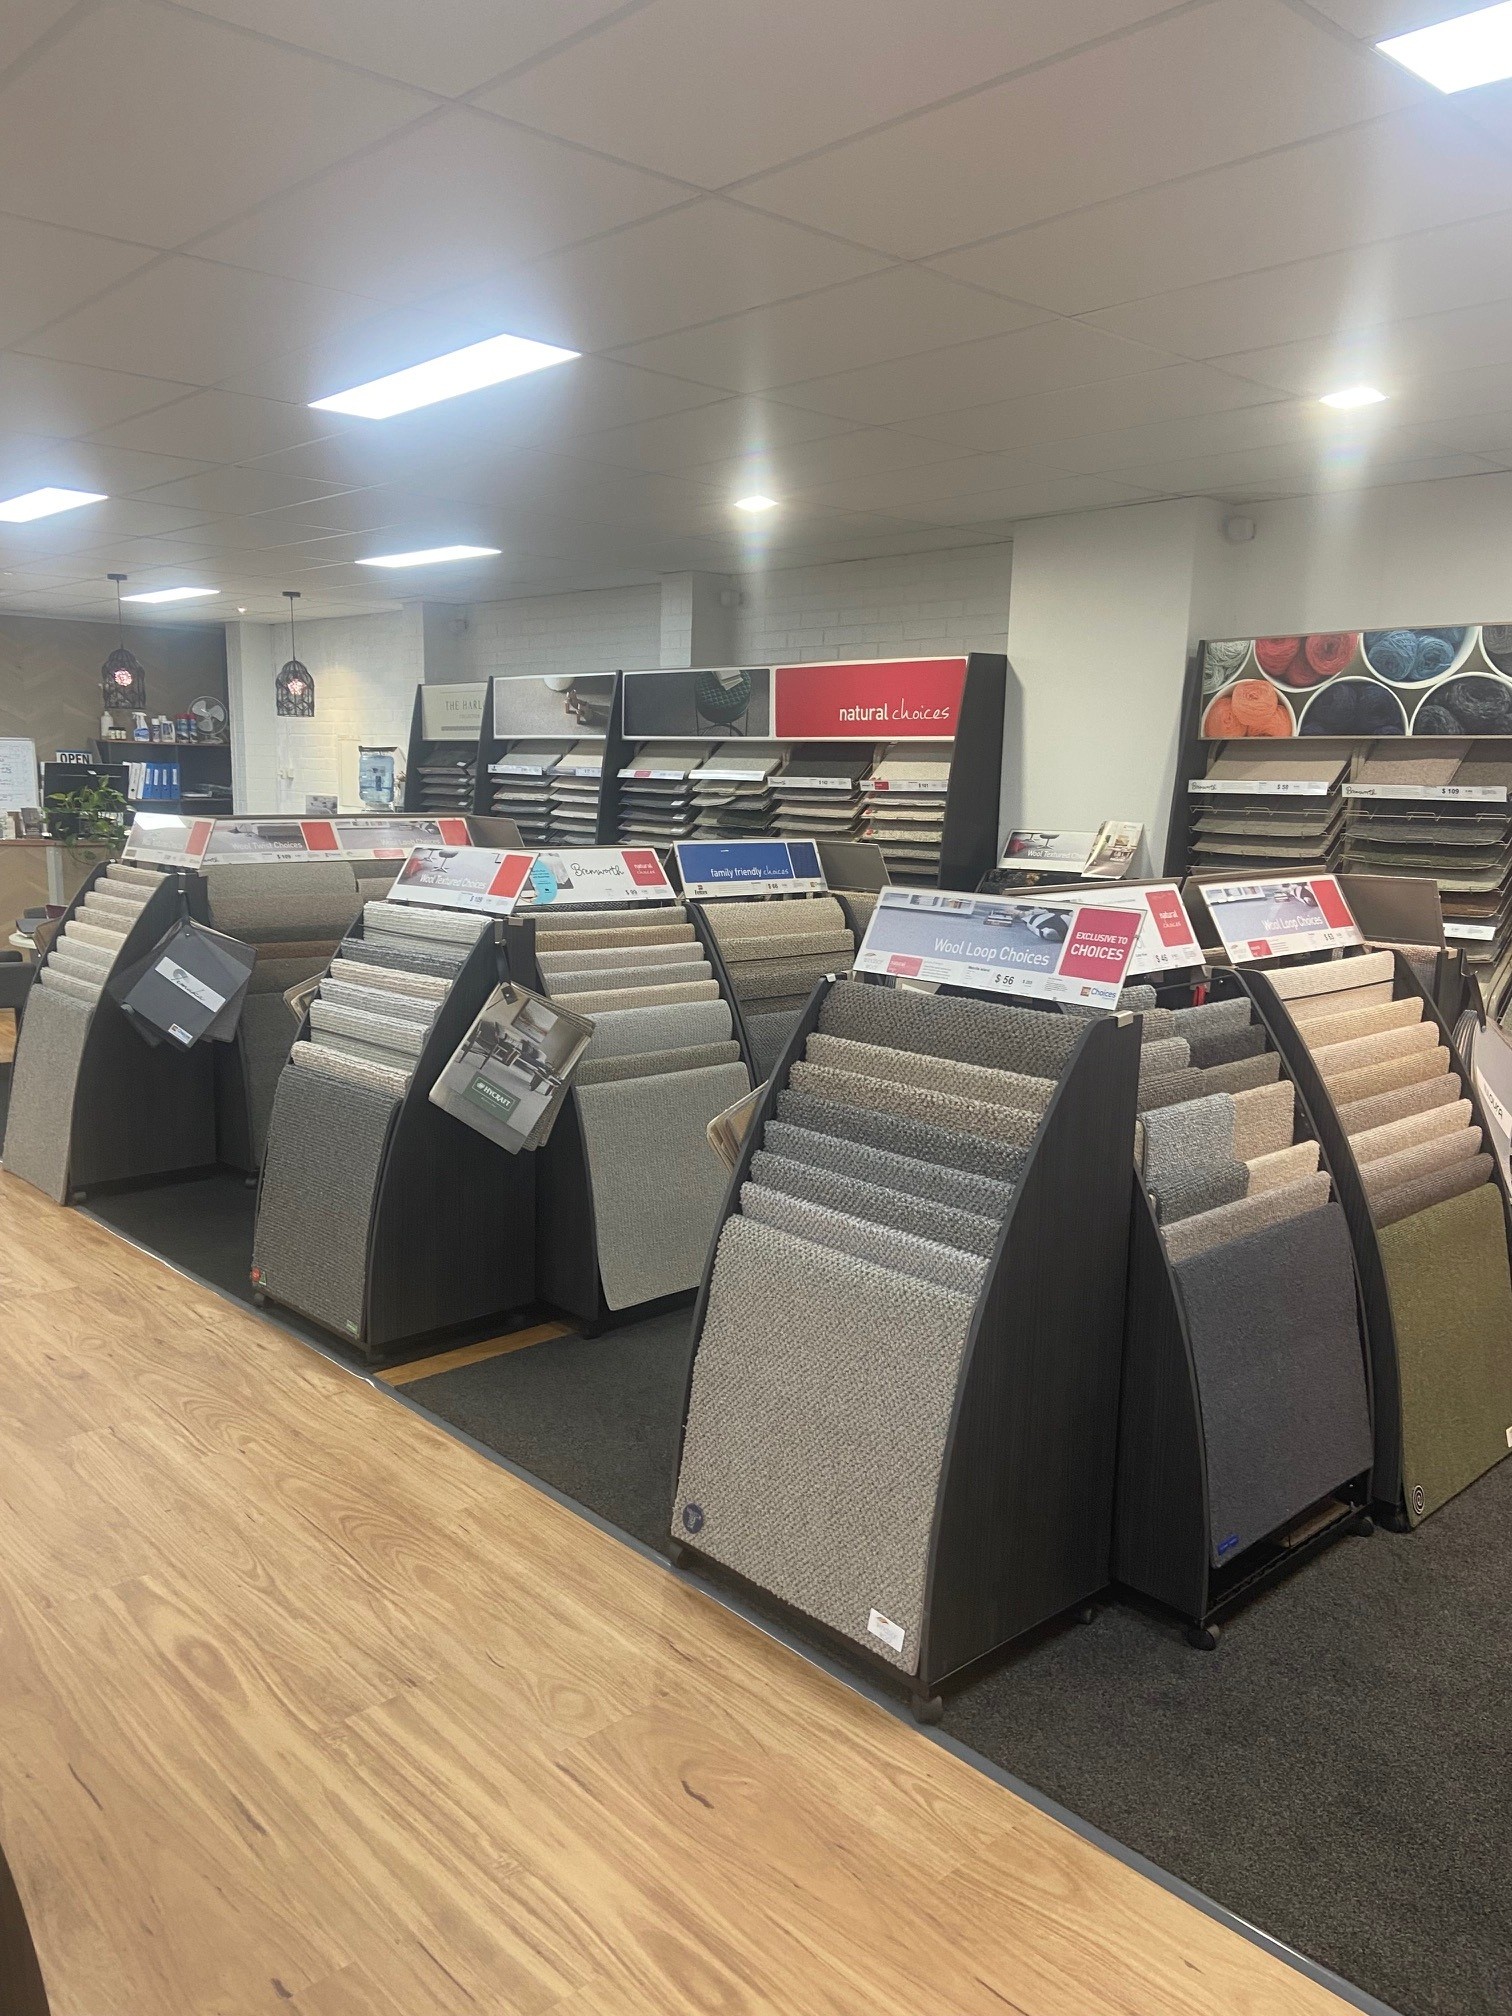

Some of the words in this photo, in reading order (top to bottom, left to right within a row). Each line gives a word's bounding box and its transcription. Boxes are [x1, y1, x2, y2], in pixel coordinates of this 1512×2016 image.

[445, 700, 459, 711] THE
[462, 700, 484, 710] HARL
[840, 703, 889, 721] natural
[892, 698, 950, 720] choices
[60, 753, 90, 764] OPEN
[274, 841, 303, 849] Choices
[1027, 849, 1044, 857] Wool
[570, 863, 625, 877] Bremworth
[710, 868, 734, 878] family
[734, 867, 762, 878] friendly
[763, 865, 789, 875] choices
[420, 873, 435, 884] Wool
[436, 874, 462, 887] Textured
[462, 878, 487, 890] Choices
[1159, 909, 1179, 919] natural
[1262, 919, 1280, 931] Wool
[1281, 918, 1298, 930] Loop
[1299, 914, 1323, 927] Choices
[1075, 931, 1117, 944] EXCLUSIVE
[1118, 936, 1129, 945] TO
[934, 938, 963, 955] Wool
[966, 942, 997, 962] Loop
[999, 946, 1050, 966] Choices
[1070, 943, 1125, 961] CHOICES
[994, 974, 1002, 984] $
[1002, 976, 1014, 985] 56
[1090, 988, 1117, 998] Choices
[483, 1086, 511, 1108] HYCRAFT
